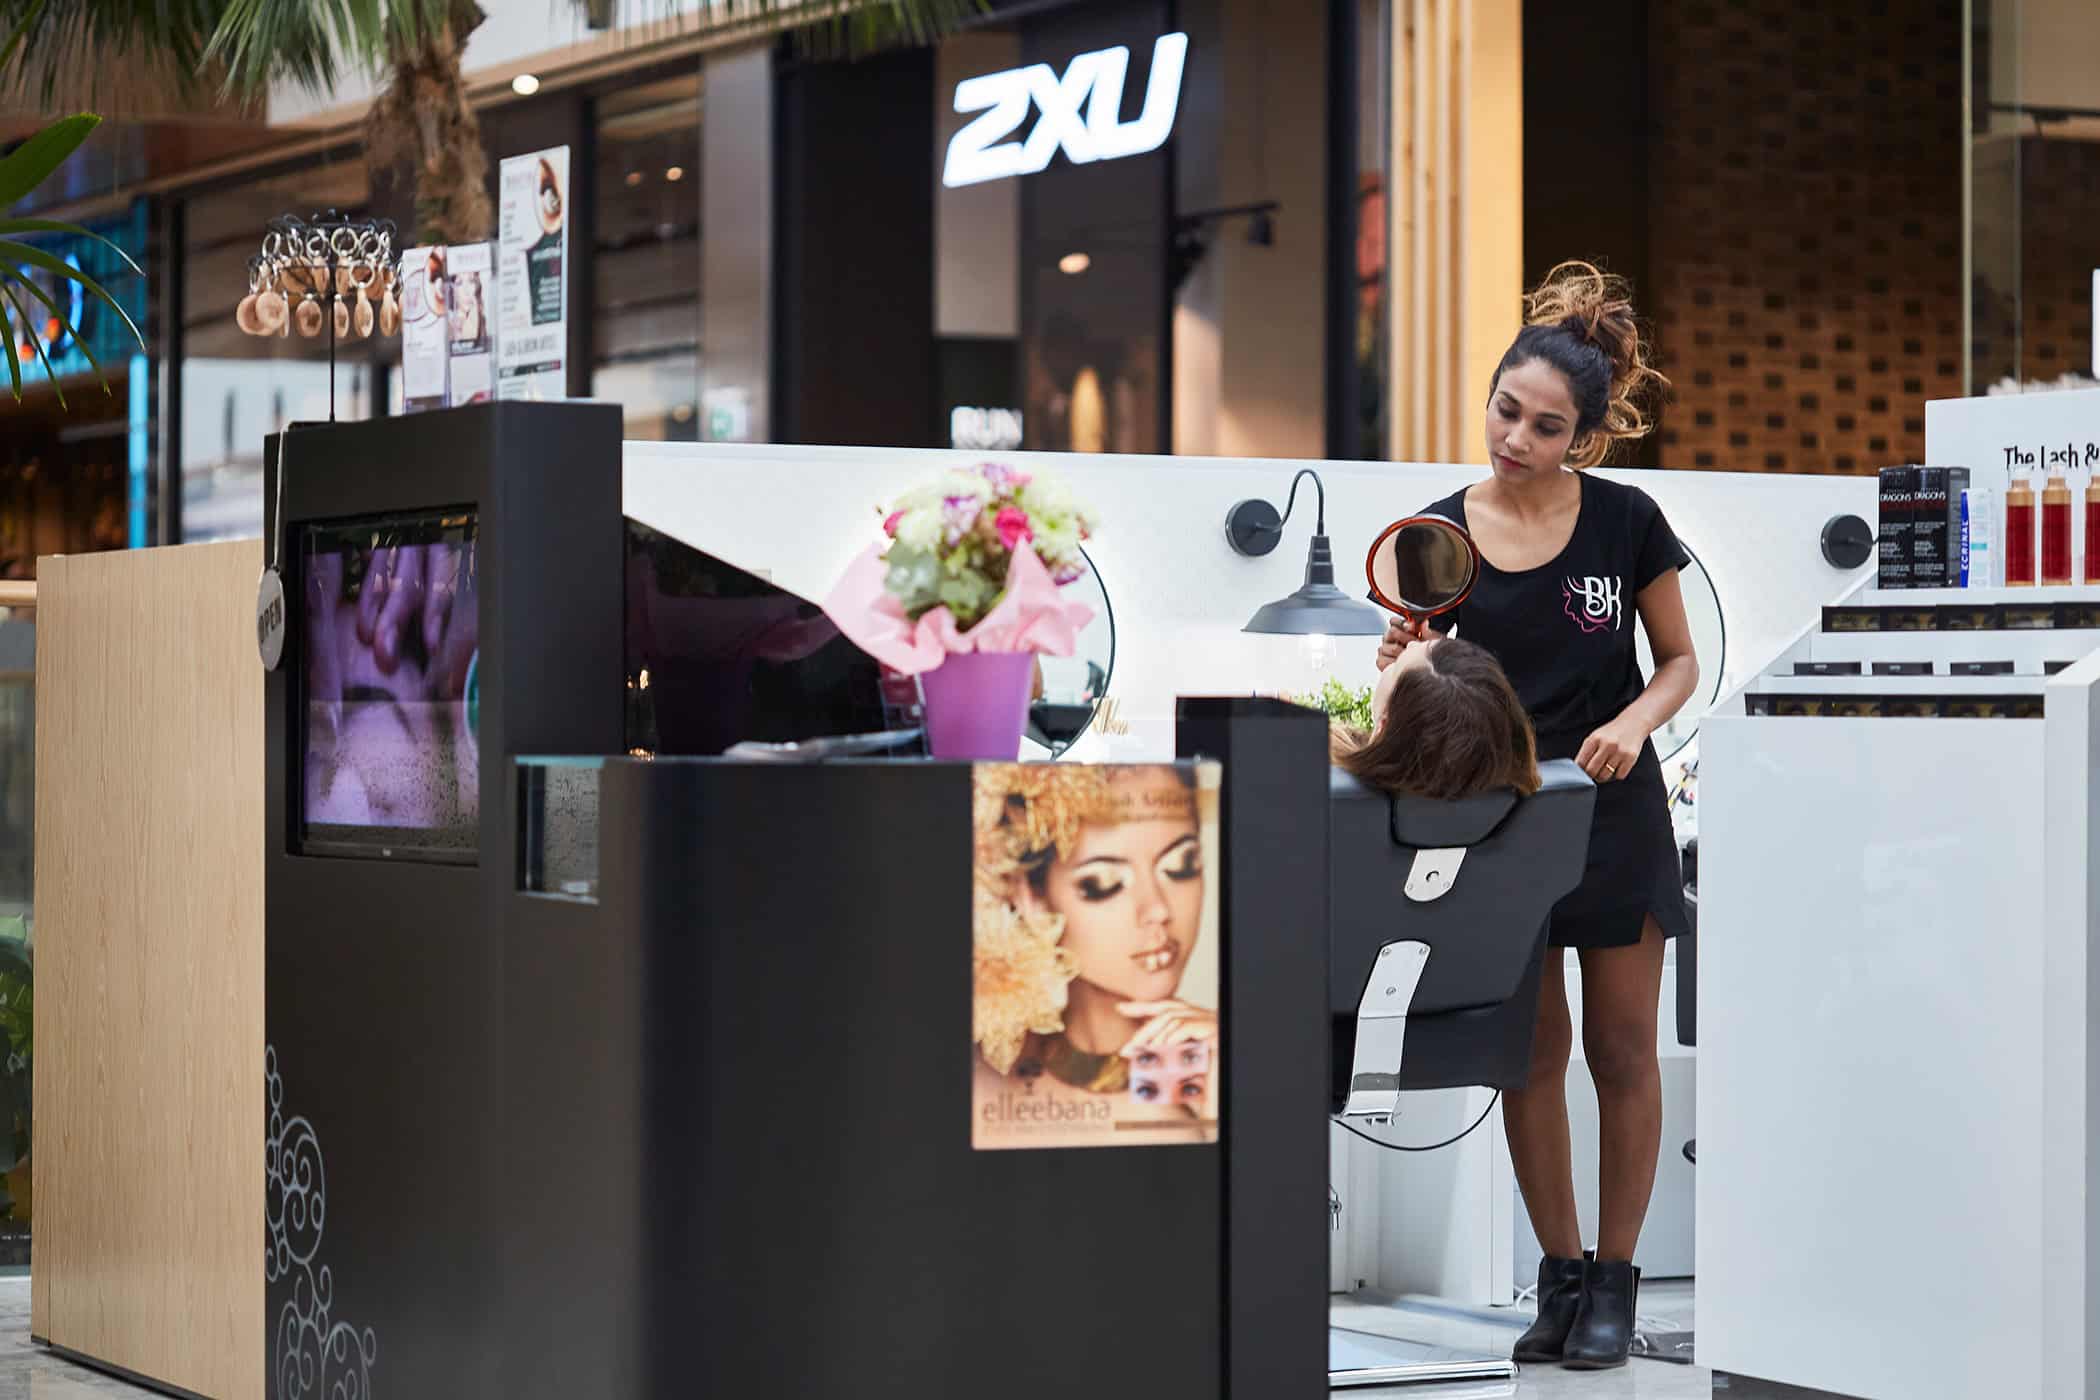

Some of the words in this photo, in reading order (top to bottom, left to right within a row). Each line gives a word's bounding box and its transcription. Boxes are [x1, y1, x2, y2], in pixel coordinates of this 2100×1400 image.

[943, 32, 1188, 188] 2XU
[2003, 444, 2035, 470] The
[258, 596, 282, 644] OPEN
[983, 1091, 1112, 1122] elleebana
